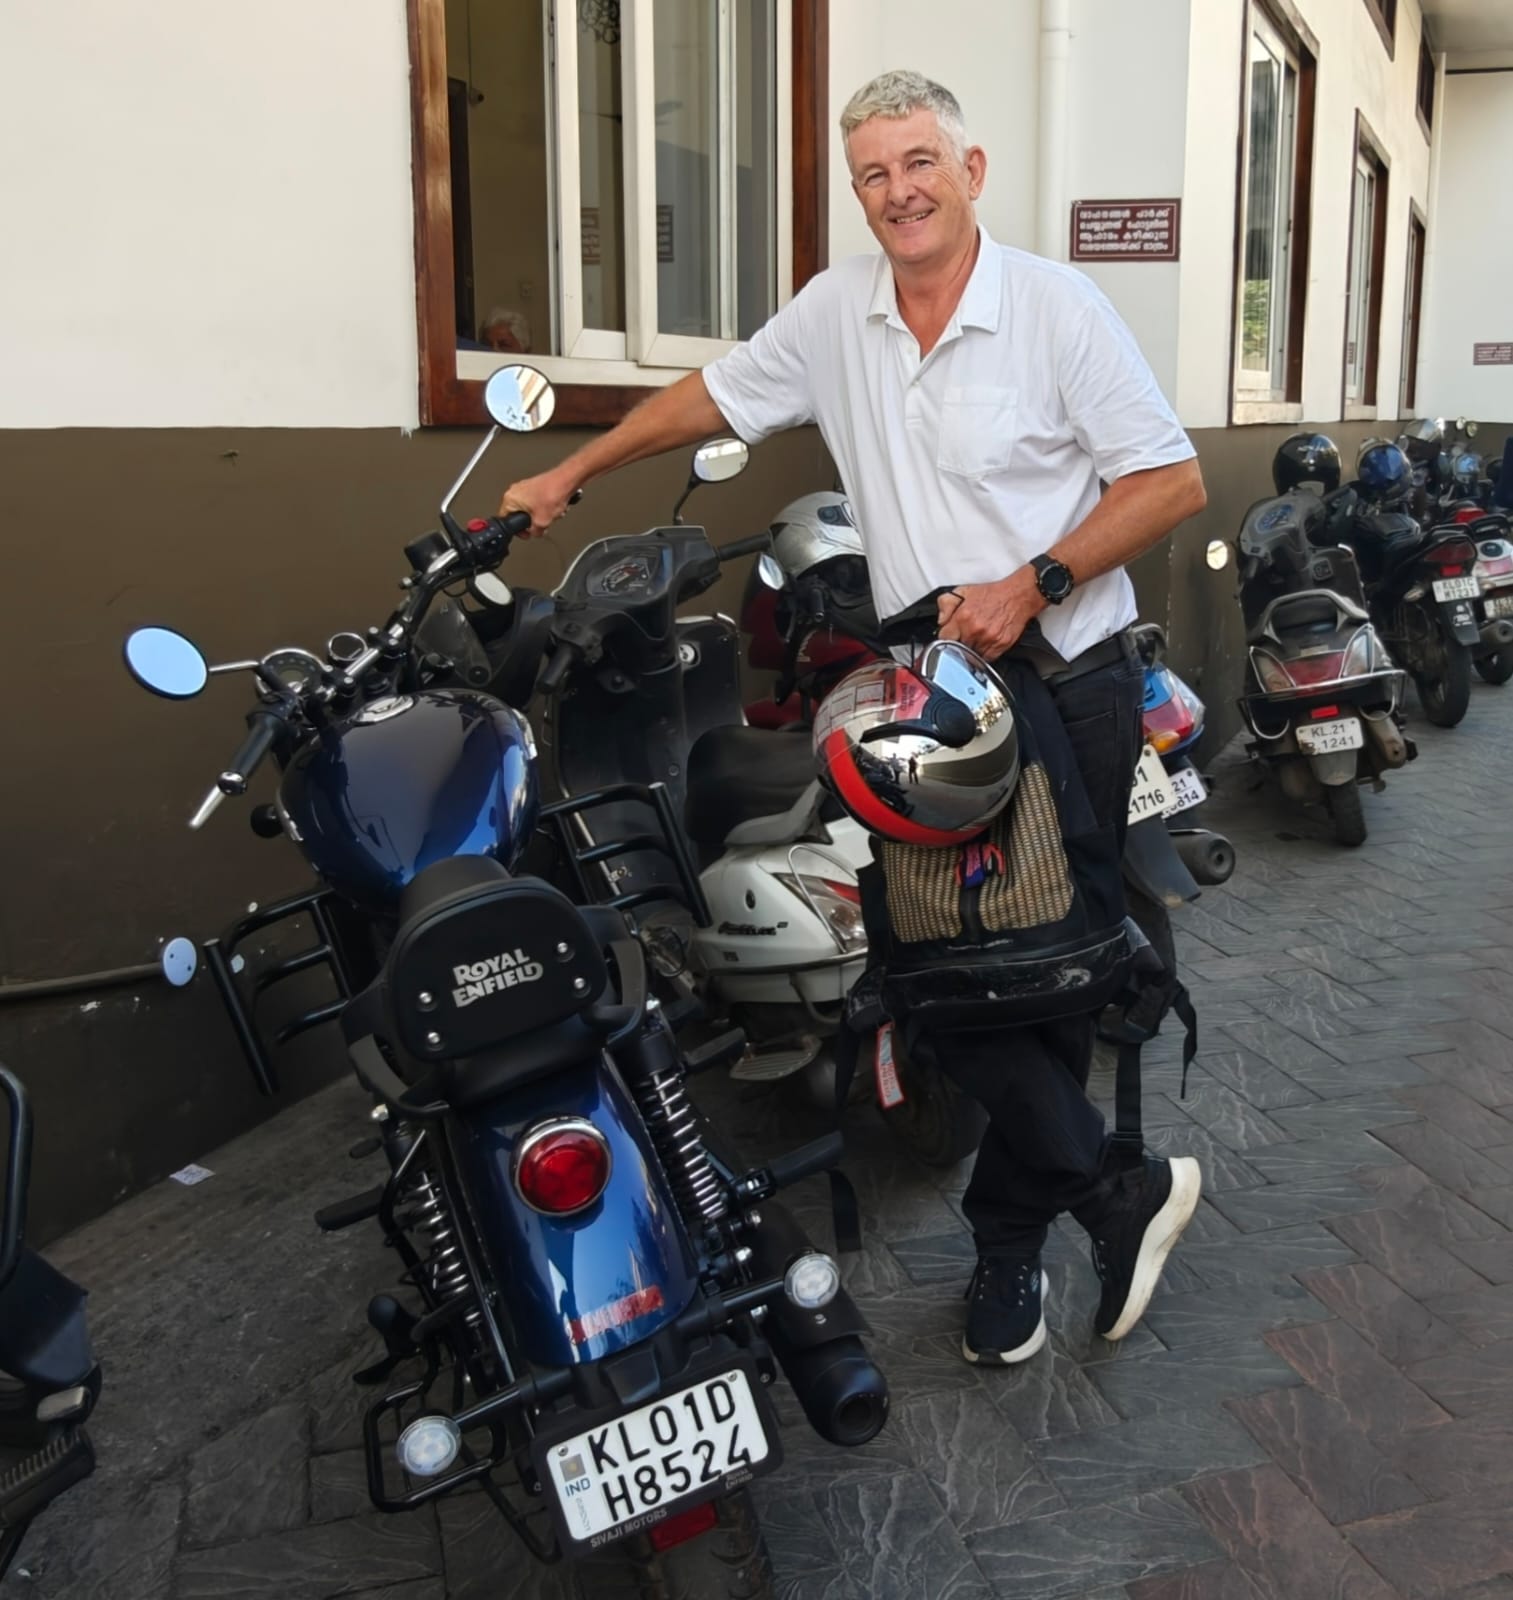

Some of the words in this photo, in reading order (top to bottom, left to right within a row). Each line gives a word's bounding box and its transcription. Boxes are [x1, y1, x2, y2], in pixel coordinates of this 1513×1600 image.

[452, 962, 544, 1008] ENFIELD
[453, 948, 530, 986] ROYAL
[588, 1379, 736, 1475] KL01D
[565, 1478, 591, 1497] IND
[602, 1424, 752, 1522] H8524
[590, 1525, 623, 1548] SIVAJI
[624, 1507, 668, 1534] MOTORS
